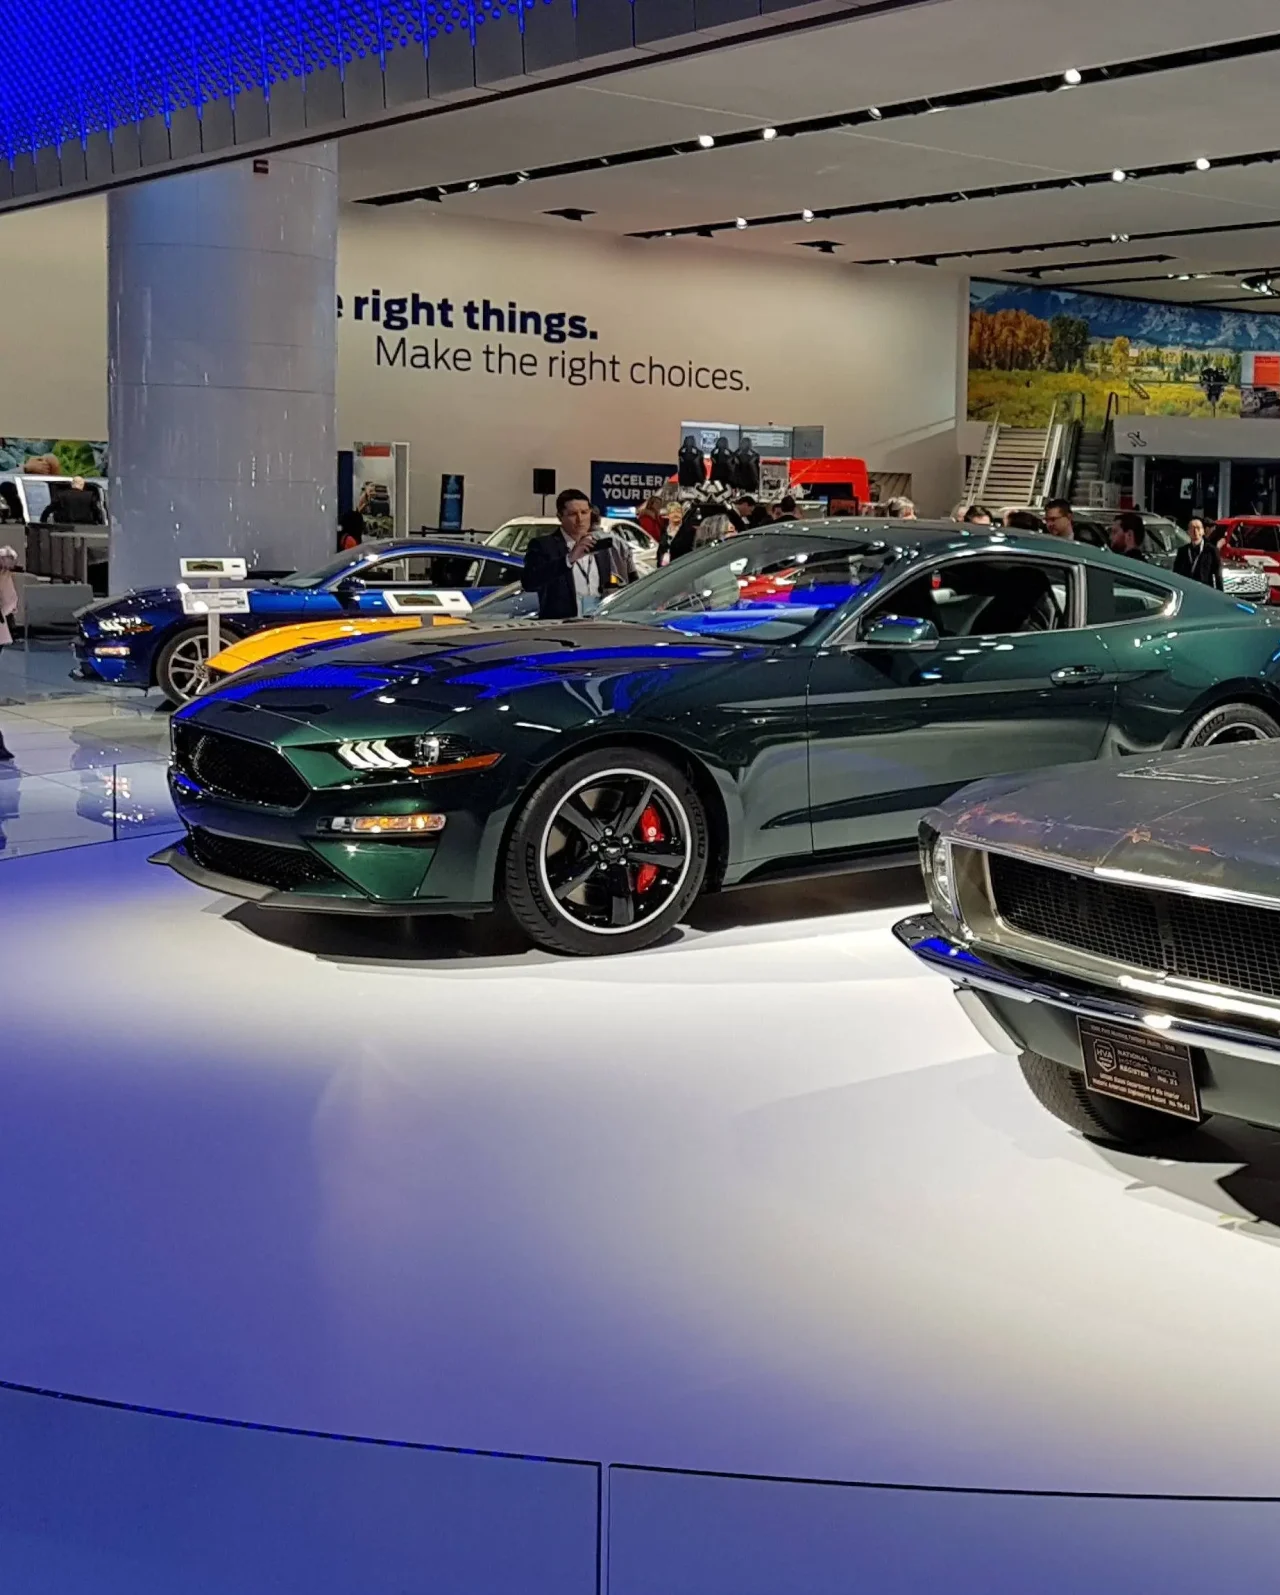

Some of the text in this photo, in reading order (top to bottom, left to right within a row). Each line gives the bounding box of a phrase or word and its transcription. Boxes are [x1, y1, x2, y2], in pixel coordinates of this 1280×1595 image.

[354, 289, 454, 330] right
[463, 299, 598, 343] things.
[376, 335, 750, 392] Make the right choices.
[602, 488, 640, 500] YOUR
[1096, 1048, 1114, 1060] HVA
